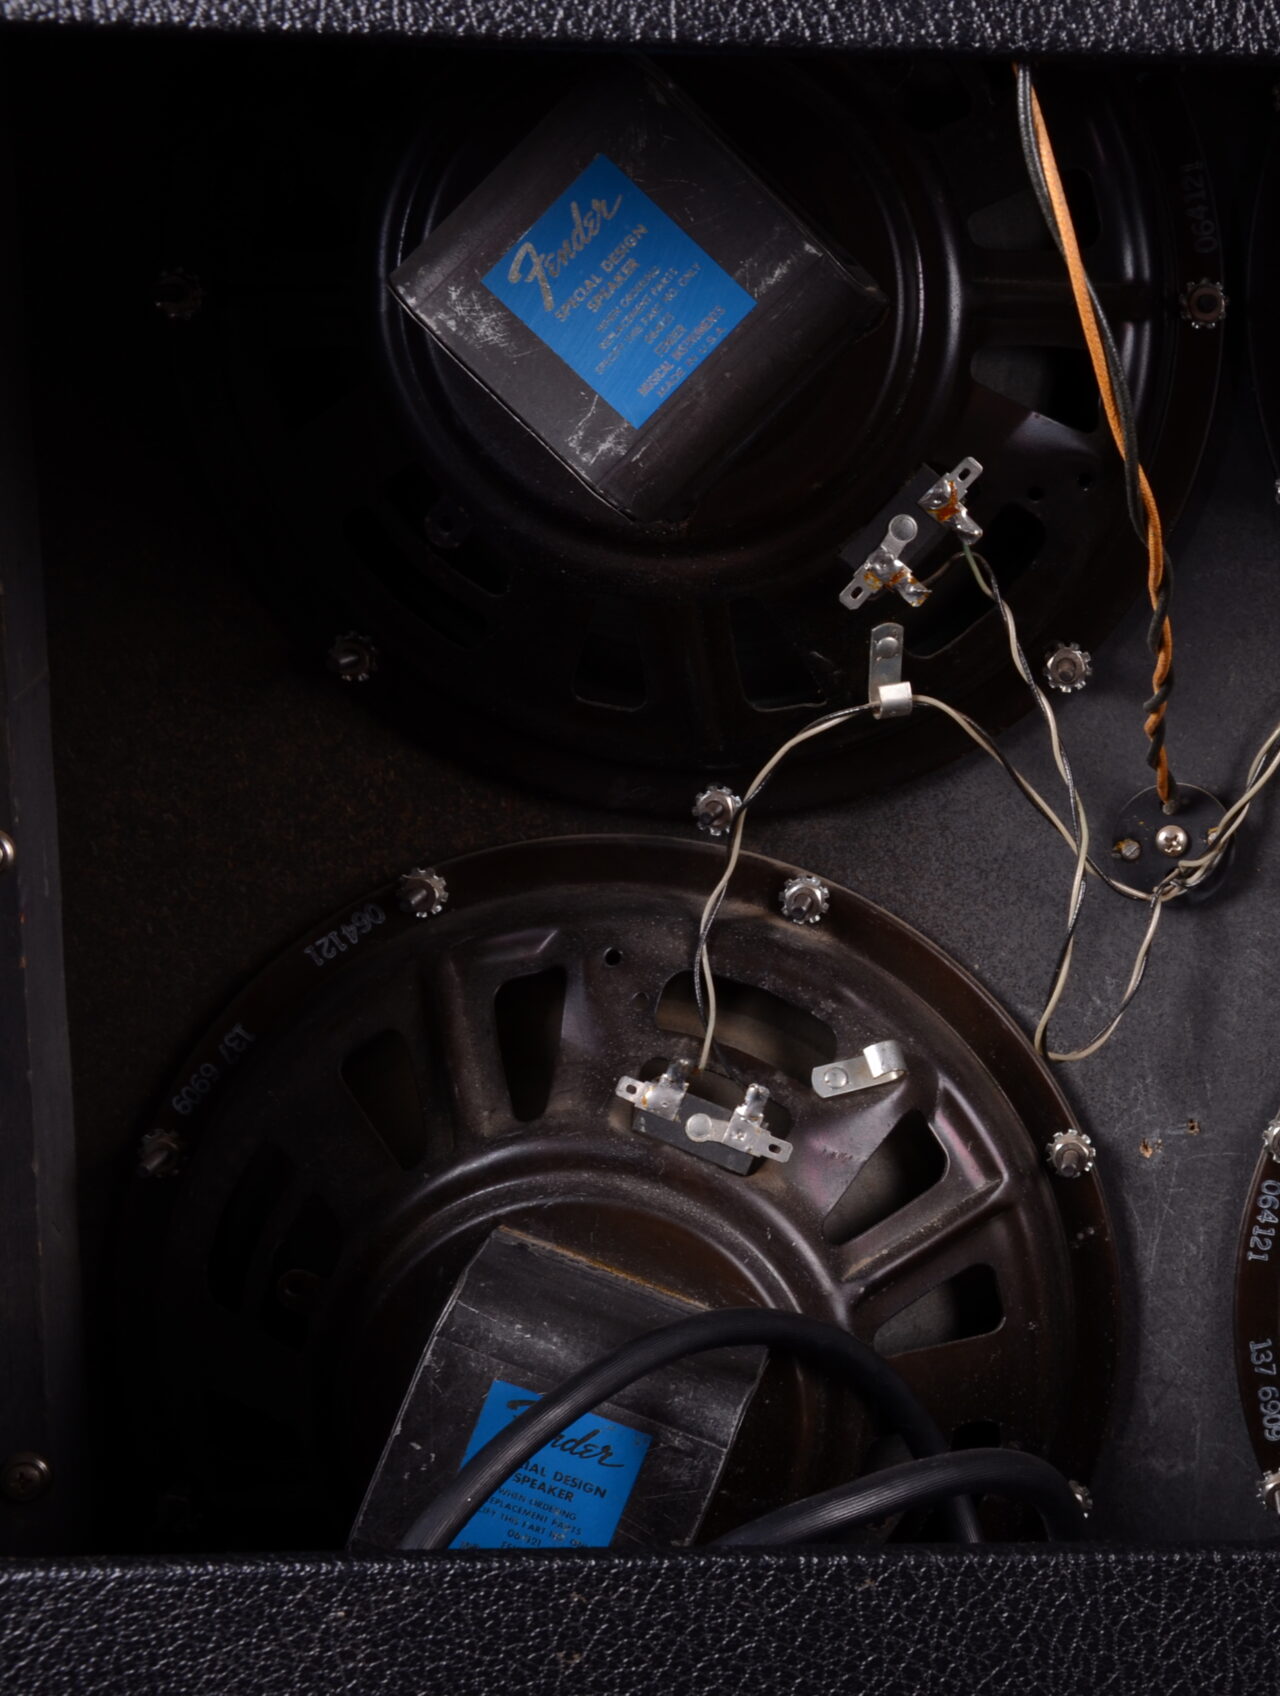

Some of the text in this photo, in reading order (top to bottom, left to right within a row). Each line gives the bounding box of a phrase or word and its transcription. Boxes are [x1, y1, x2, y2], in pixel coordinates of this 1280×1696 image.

[507, 194, 623, 312] Fender
[600, 224, 648, 271] DESIGN
[1250, 1338, 1277, 1376] 137
[513, 1472, 574, 1501] SPEAKER
[552, 1472, 606, 1497] DESIGN
[488, 1496, 547, 1522] EPLACEMENT
